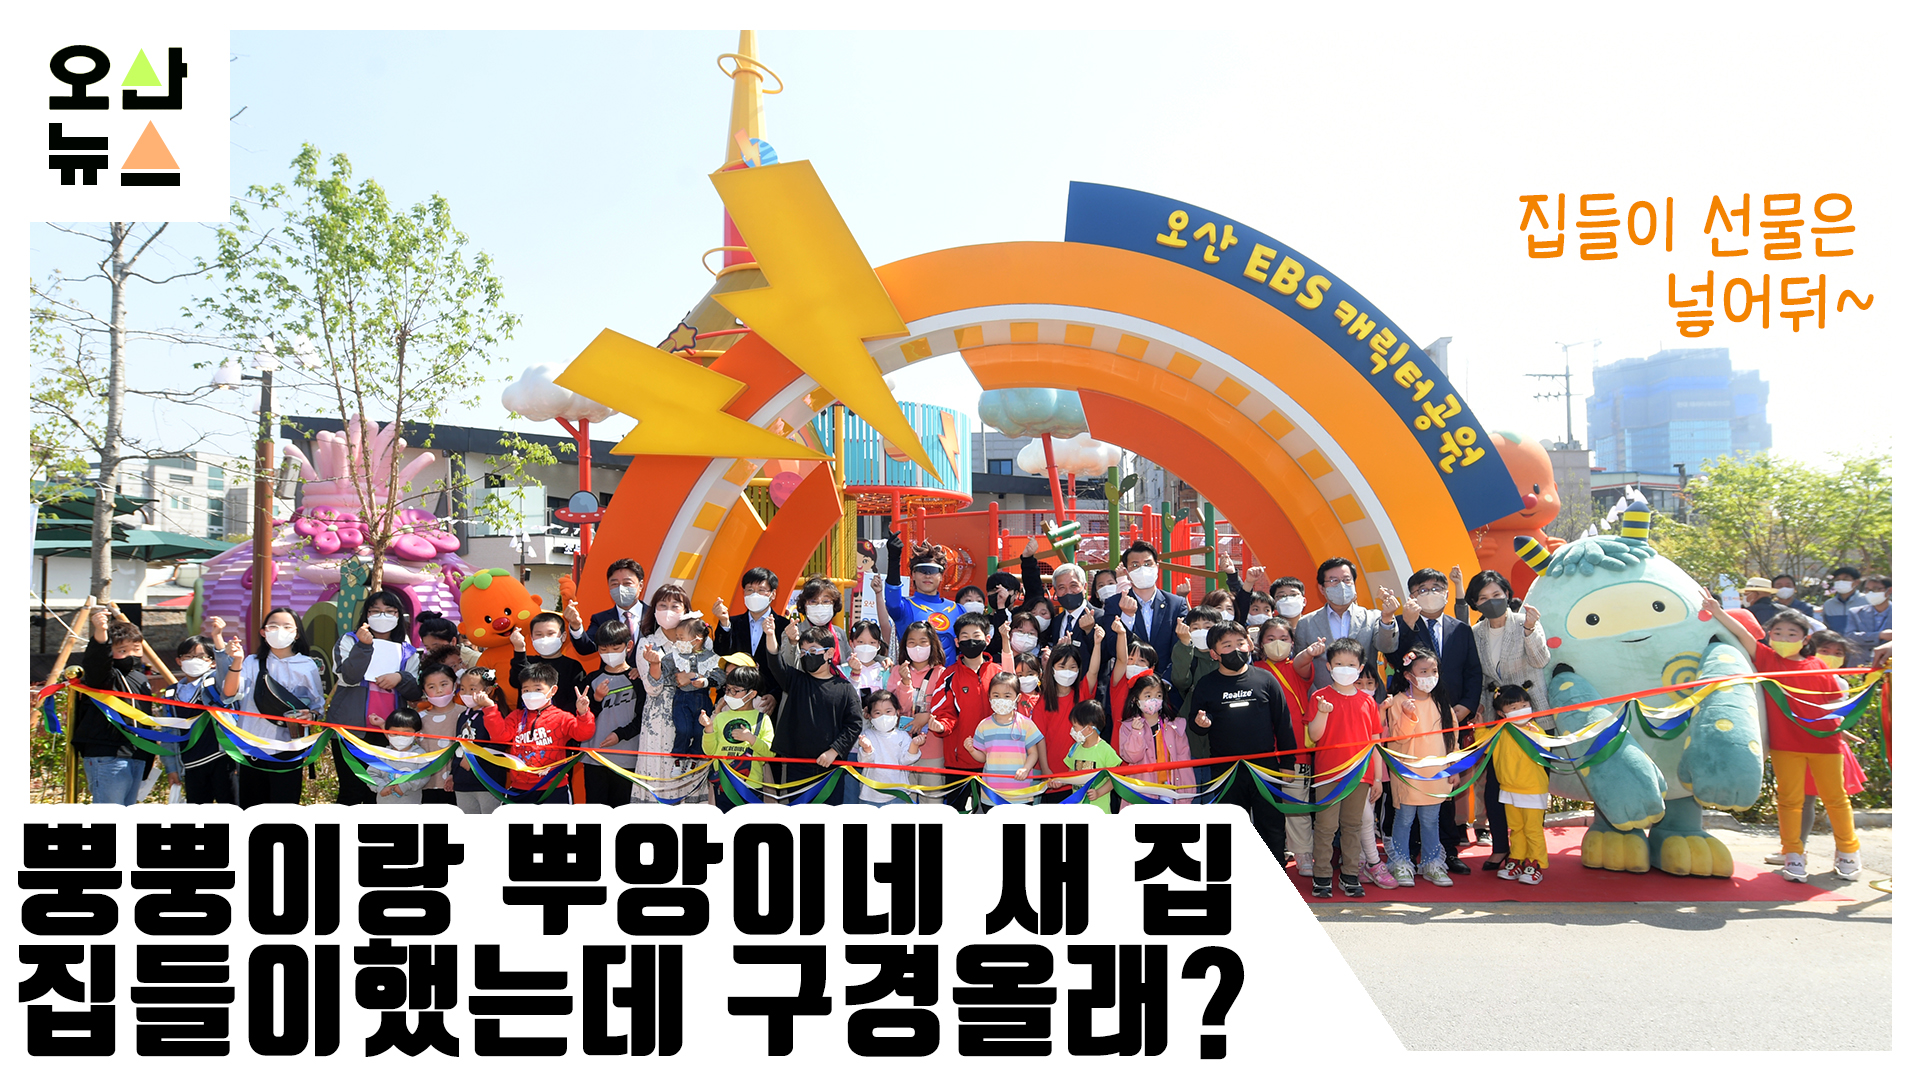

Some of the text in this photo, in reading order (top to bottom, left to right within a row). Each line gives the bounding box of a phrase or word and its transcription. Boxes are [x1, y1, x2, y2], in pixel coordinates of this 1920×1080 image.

[1156, 209, 1486, 474] 오산 EBS 캐릭터공원
[1222, 689, 1253, 700] Realize
[1839, 857, 1855, 865] FILA
